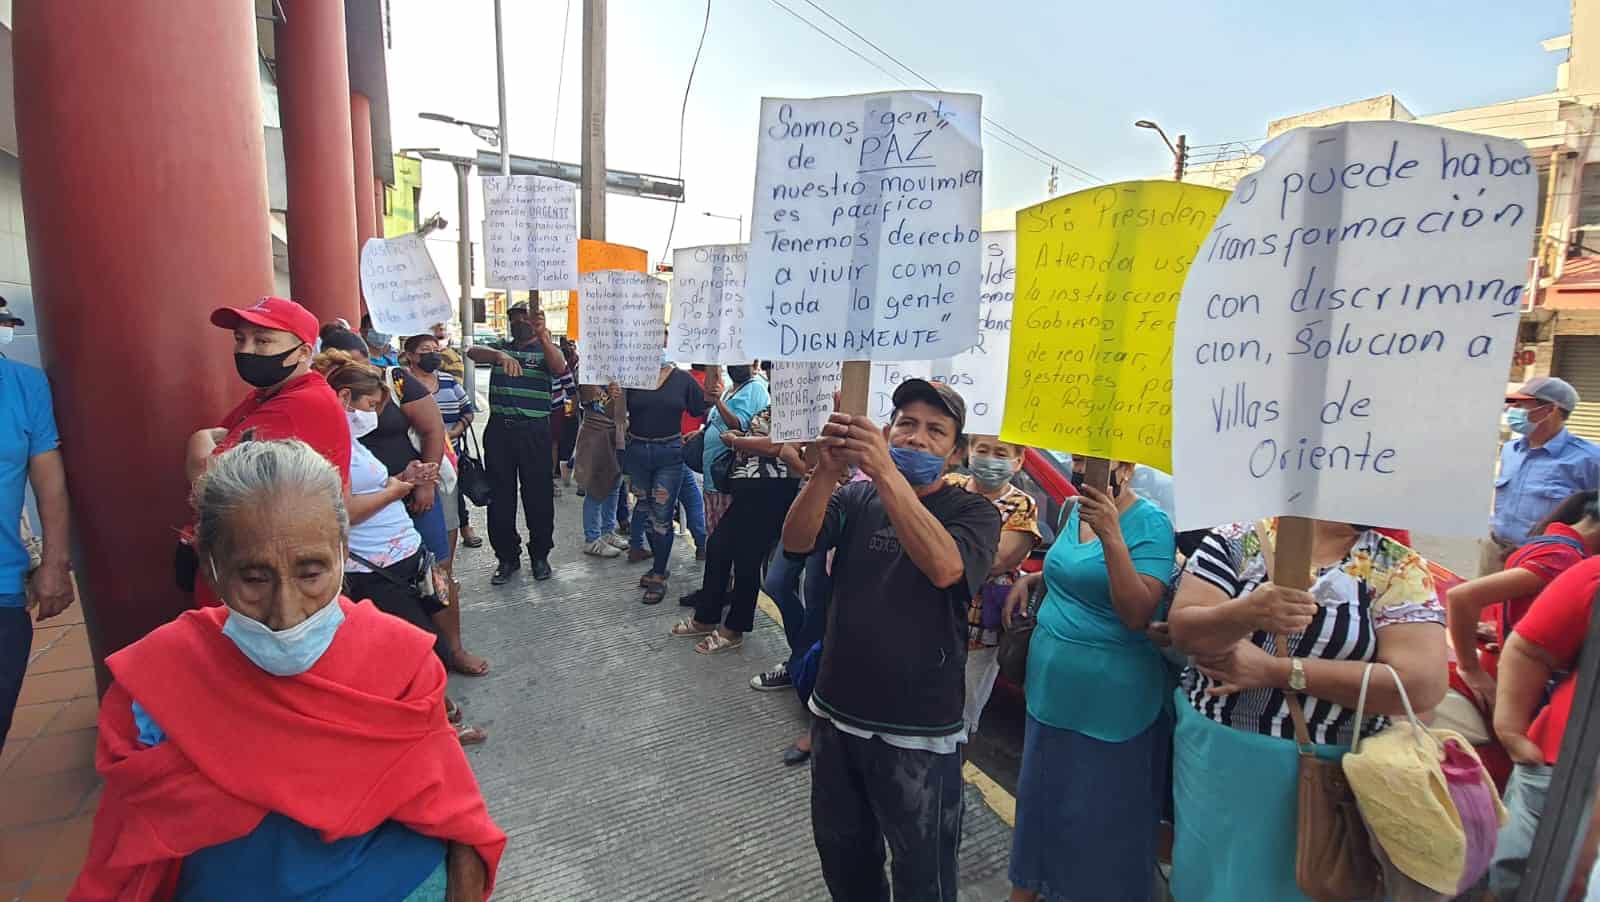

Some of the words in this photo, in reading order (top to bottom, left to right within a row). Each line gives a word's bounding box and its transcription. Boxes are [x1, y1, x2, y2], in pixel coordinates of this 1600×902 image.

[768, 103, 859, 140] Somos
[787, 144, 816, 170] de
[772, 172, 867, 200] nuestro
[1239, 178, 1257, 204] o
[1281, 139, 1419, 220] puede
[773, 207, 801, 222] es
[764, 229, 870, 252] Tenemos
[888, 218, 980, 246] derecho
[1035, 242, 1135, 274] Atienda
[775, 267, 792, 286] a
[810, 260, 870, 284] vivir
[892, 260, 961, 281] como
[765, 288, 820, 316] toda
[852, 288, 871, 311] la
[883, 283, 956, 320] gente
[1026, 277, 1040, 300] la
[1026, 306, 1115, 331] Gobierno
[1207, 292, 1260, 319] con
[1026, 342, 1047, 363] de
[1195, 338, 1273, 366] cion,
[1287, 322, 1446, 361] Solucion
[1467, 335, 1494, 358] a
[1021, 369, 1118, 391] gestiones
[1024, 390, 1040, 408] la
[1211, 381, 1280, 433] Villas
[1320, 379, 1372, 425] de
[1020, 413, 1039, 434] de
[1052, 420, 1125, 441] nuestra
[1249, 432, 1397, 478] Oriente
